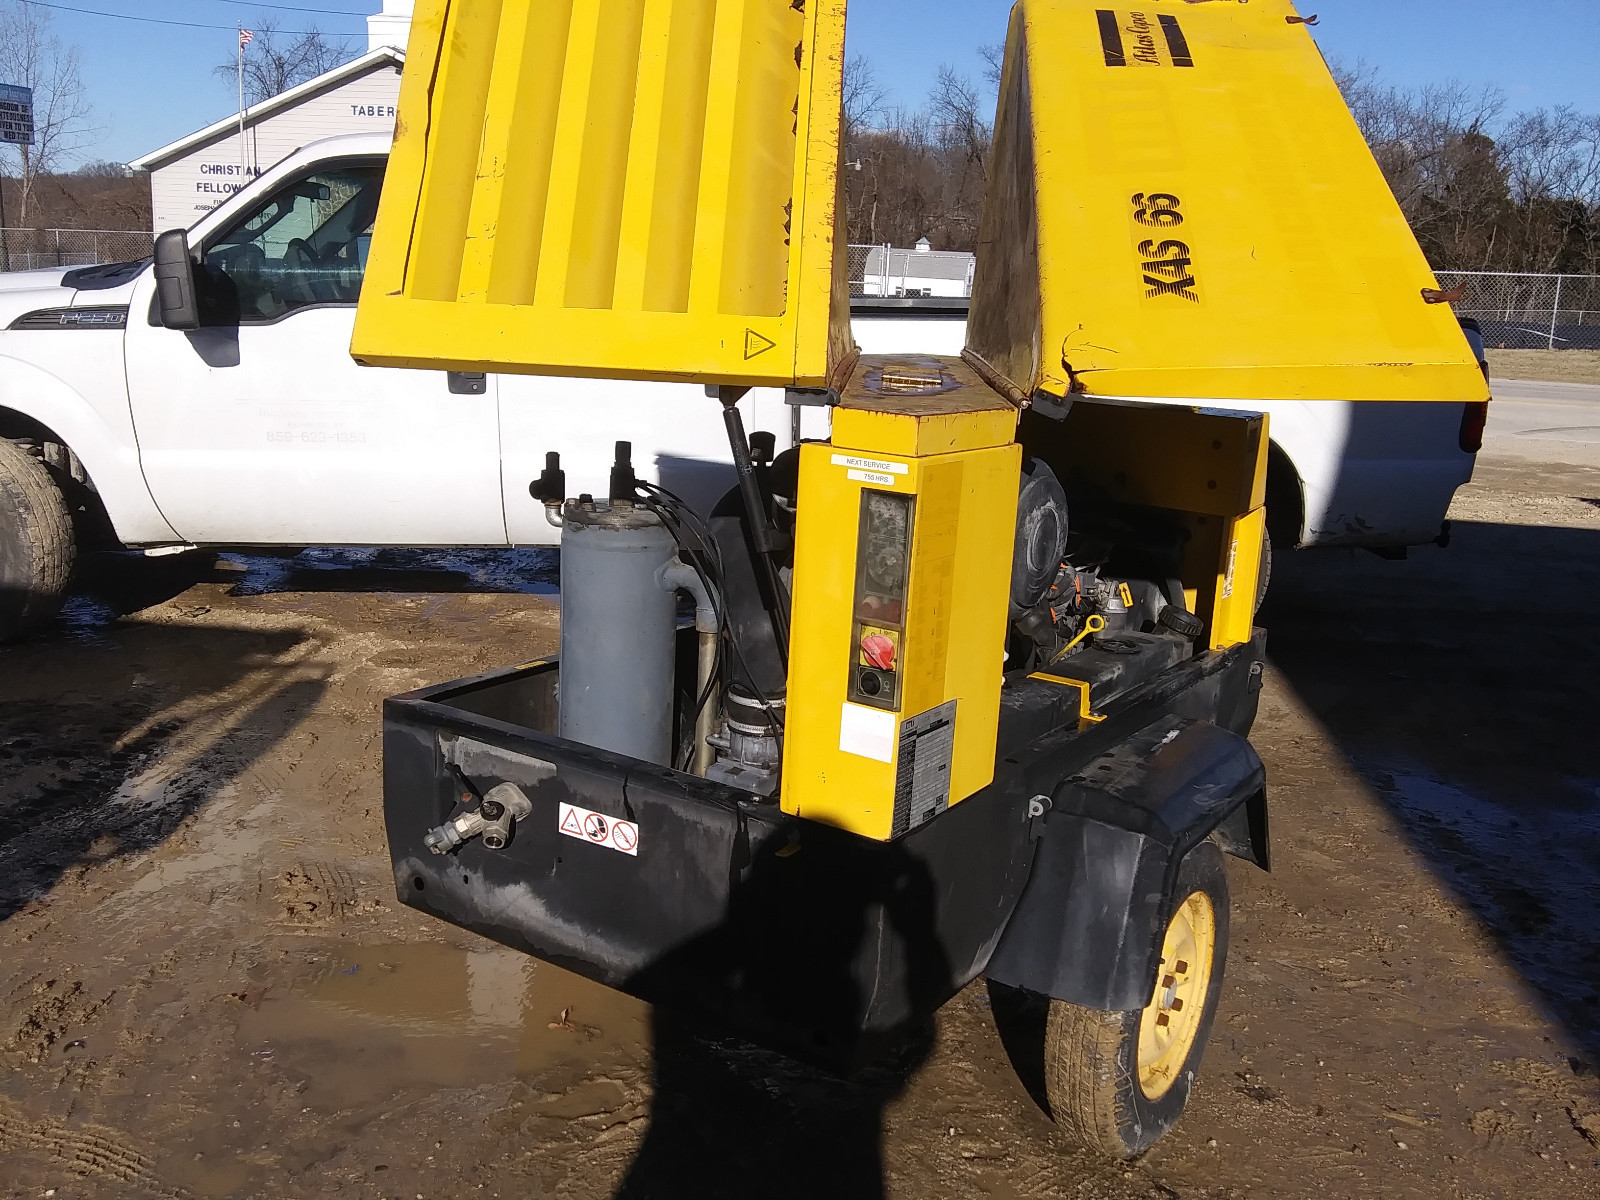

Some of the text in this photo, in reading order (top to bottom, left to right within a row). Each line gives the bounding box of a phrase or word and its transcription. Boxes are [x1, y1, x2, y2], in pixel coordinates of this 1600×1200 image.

[1126, 11, 1161, 67] Atlas Copco
[351, 105, 395, 117] TABER
[200, 164, 261, 176] CHRISTAN
[1131, 192, 1199, 304] XAS 66
[846, 458, 891, 470] NEXT SERVICE
